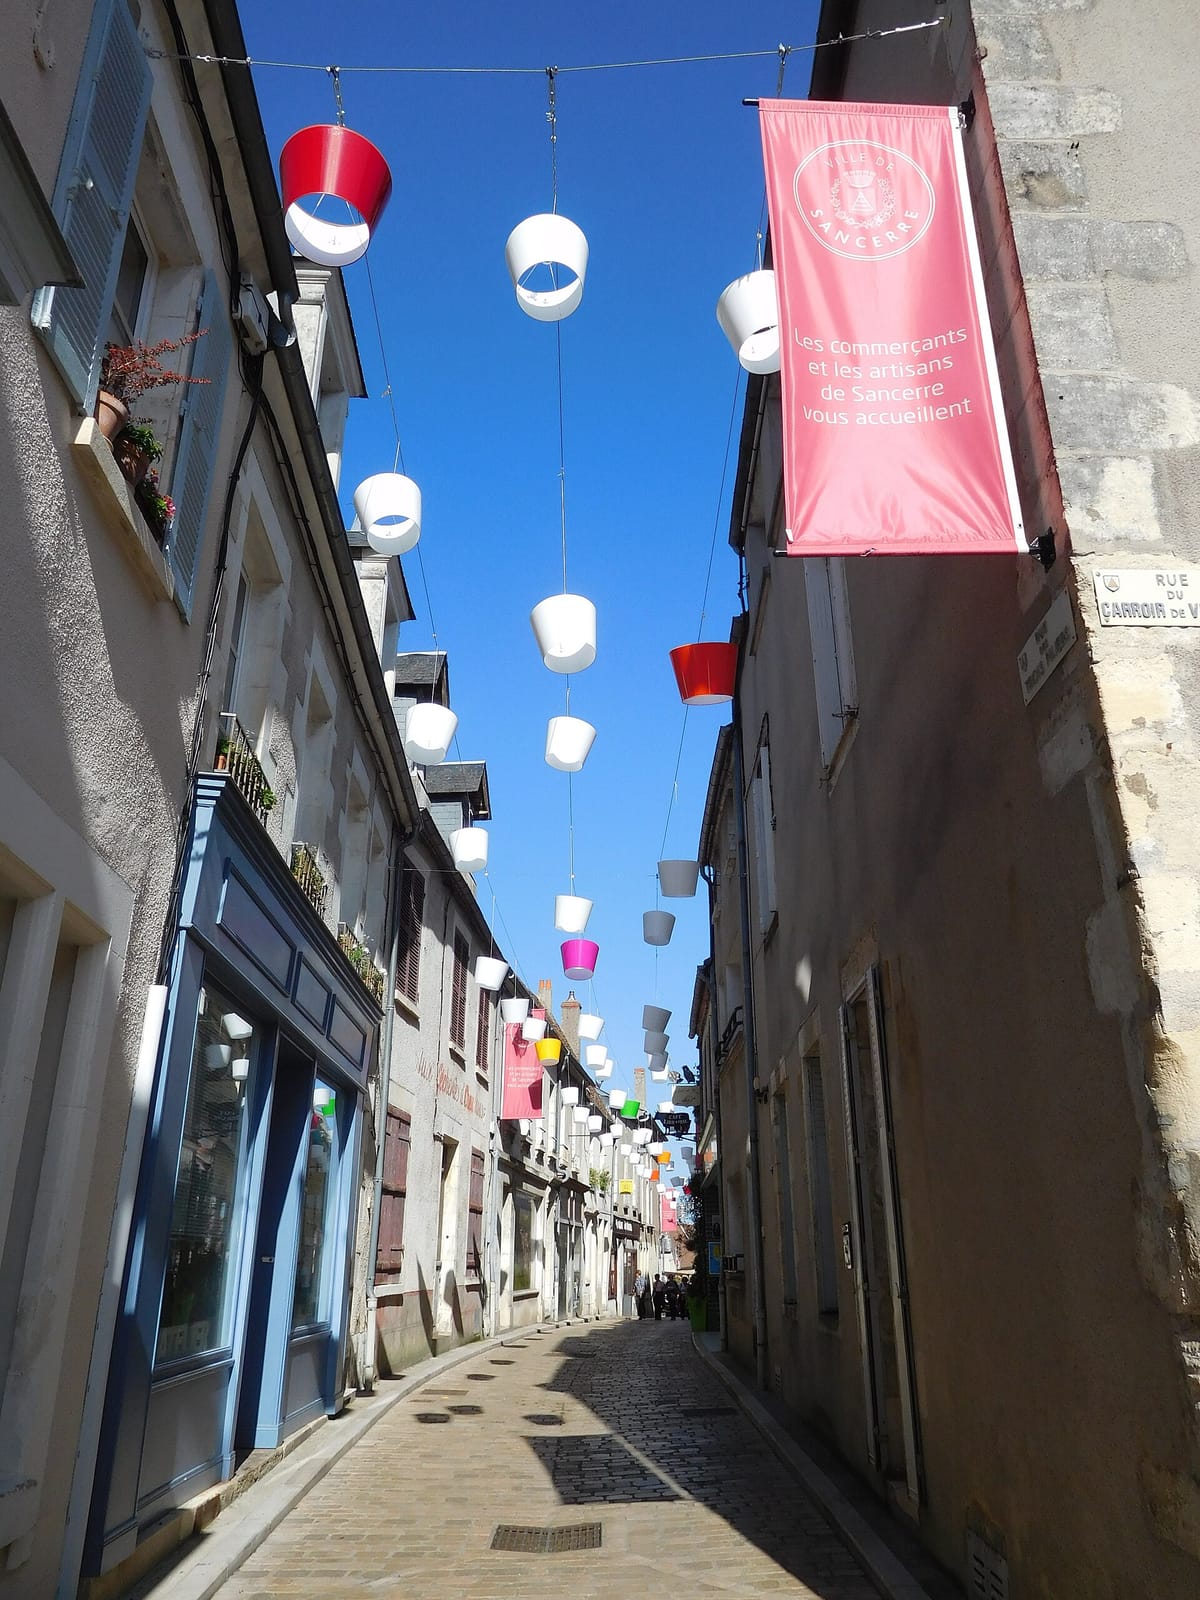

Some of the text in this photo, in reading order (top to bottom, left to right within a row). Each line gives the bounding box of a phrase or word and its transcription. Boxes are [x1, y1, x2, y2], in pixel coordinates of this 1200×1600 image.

[823, 153, 895, 173] VILLE DE
[810, 208, 919, 249] SANCERRE
[794, 327, 968, 357] Les commerçants
[808, 355, 954, 379] et les artisans
[820, 382, 945, 403] de Sancerre
[803, 397, 973, 425] vous accueillent
[1155, 574, 1189, 587] RUE
[1166, 590, 1184, 600] DU
[1101, 602, 1167, 619] CARROIR
[1170, 608, 1186, 619] DE
